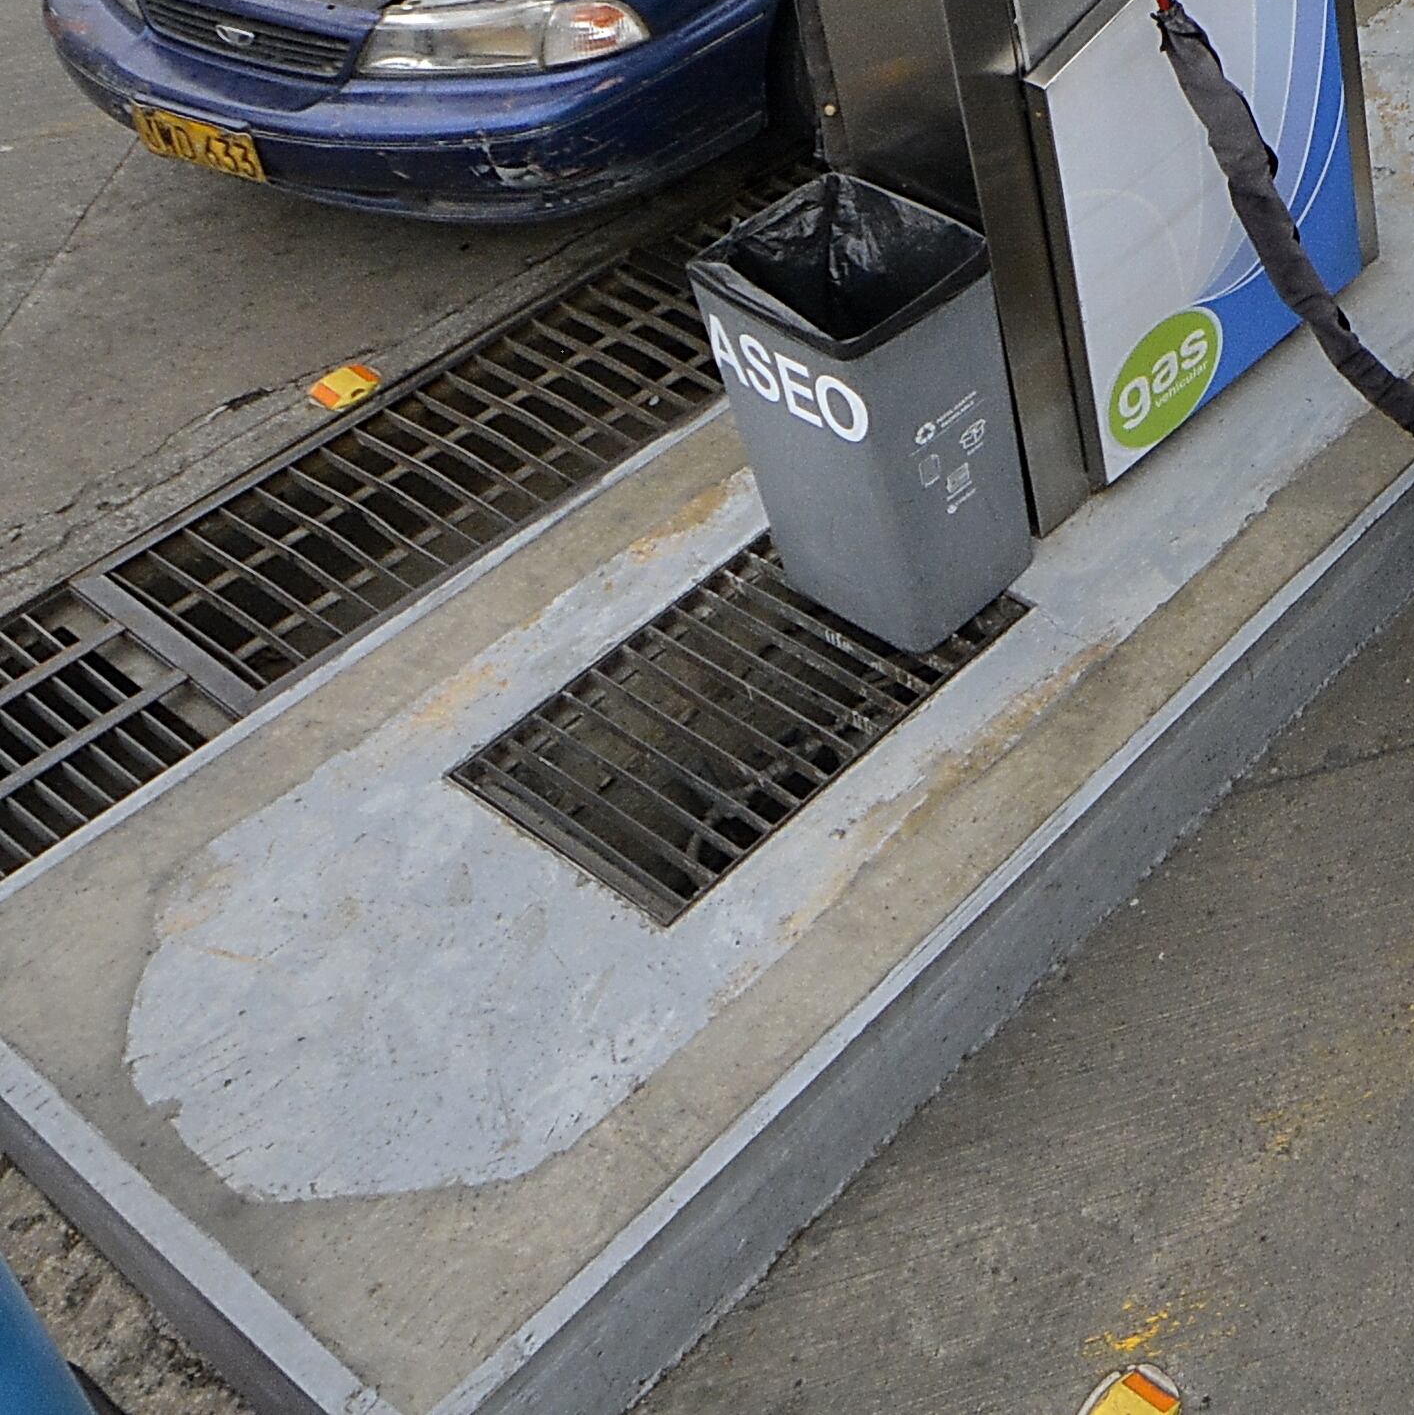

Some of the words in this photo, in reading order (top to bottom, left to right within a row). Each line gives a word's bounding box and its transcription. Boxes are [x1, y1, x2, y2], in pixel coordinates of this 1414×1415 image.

[204, 136, 257, 178] 633
[708, 313, 869, 443] ASEO
[1118, 328, 1208, 430] gas
[1155, 359, 1209, 408] vehicular
